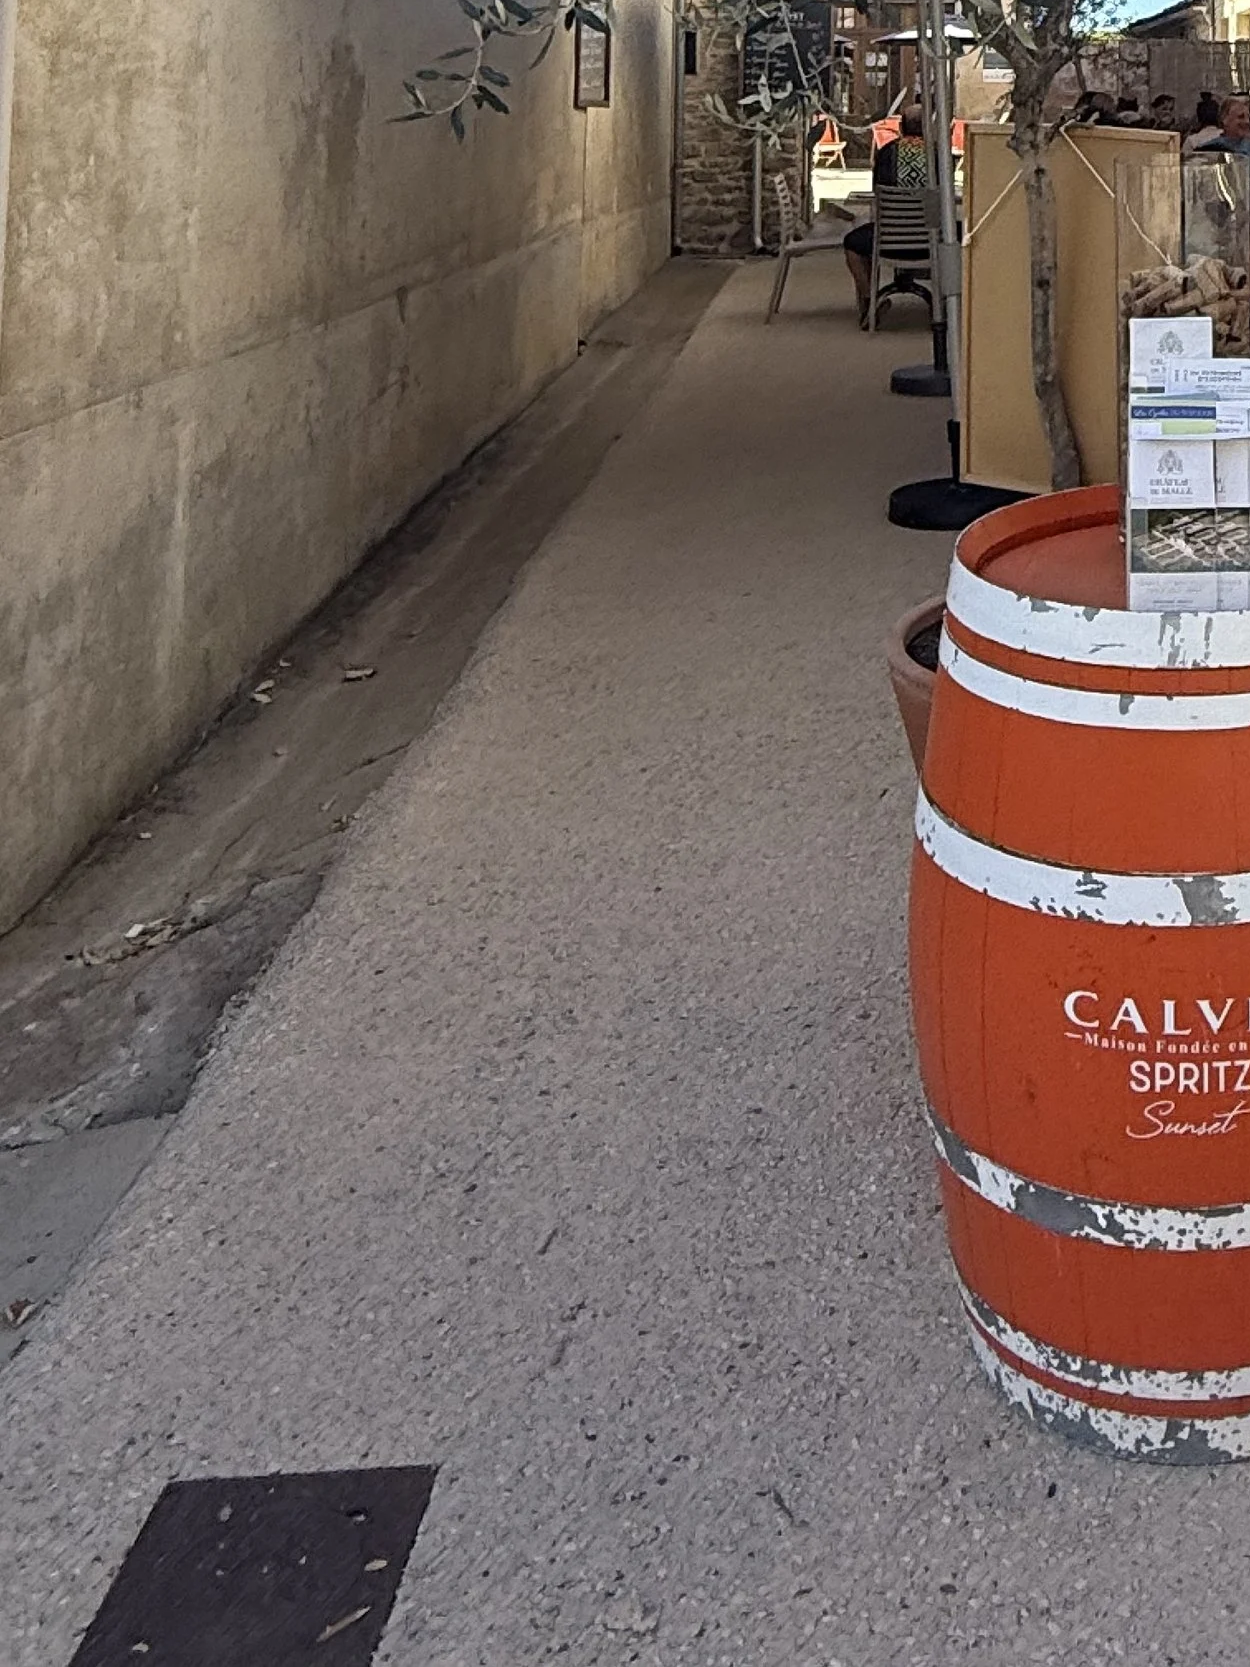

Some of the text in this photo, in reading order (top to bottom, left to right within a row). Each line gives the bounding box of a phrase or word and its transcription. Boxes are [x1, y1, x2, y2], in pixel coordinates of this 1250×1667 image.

[1084, 1032, 1147, 1053] Maison
[1156, 1039, 1221, 1054] Fondée
[1228, 1041, 1248, 1053] en
